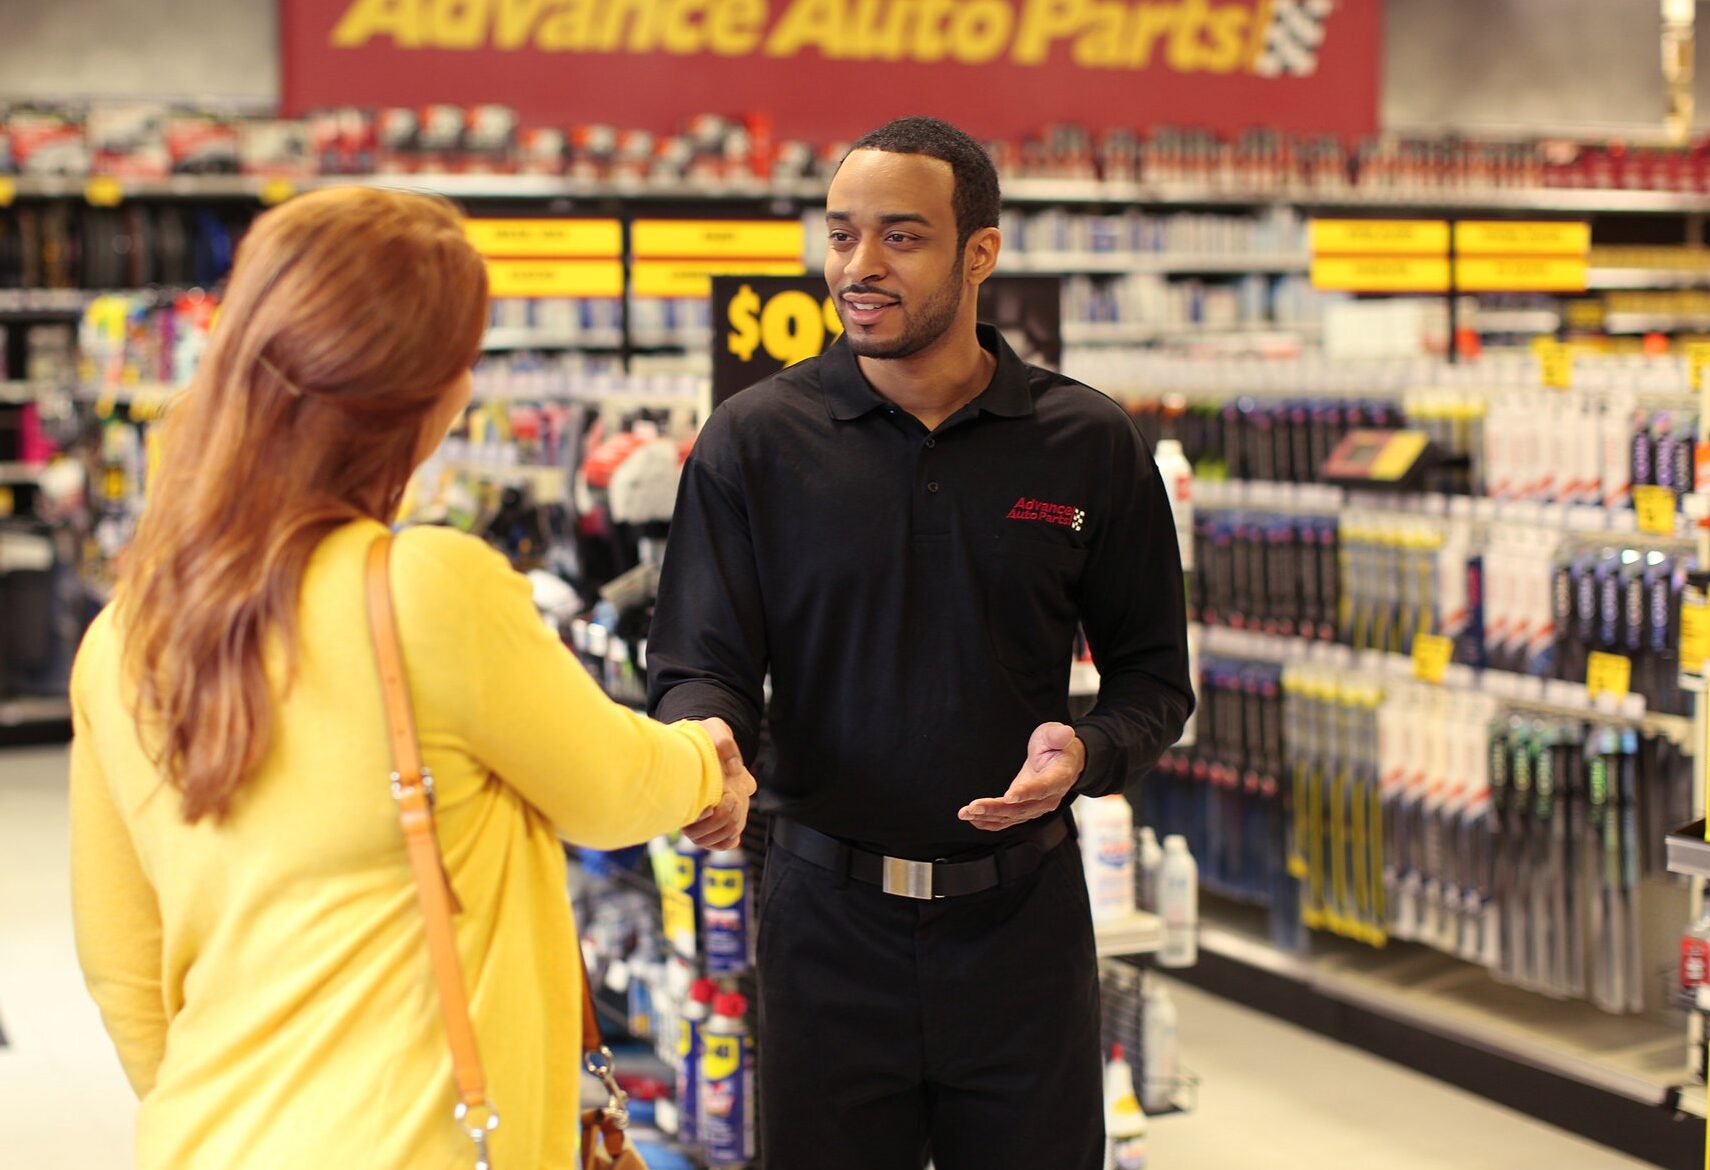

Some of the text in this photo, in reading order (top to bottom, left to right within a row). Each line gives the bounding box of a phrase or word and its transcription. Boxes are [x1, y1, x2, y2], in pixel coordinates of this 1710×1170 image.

[328, 0, 763, 56] Advance
[763, 0, 1011, 64] Auto
[1006, 509, 1037, 520] Auto
[1013, 497, 1073, 515] Advance
